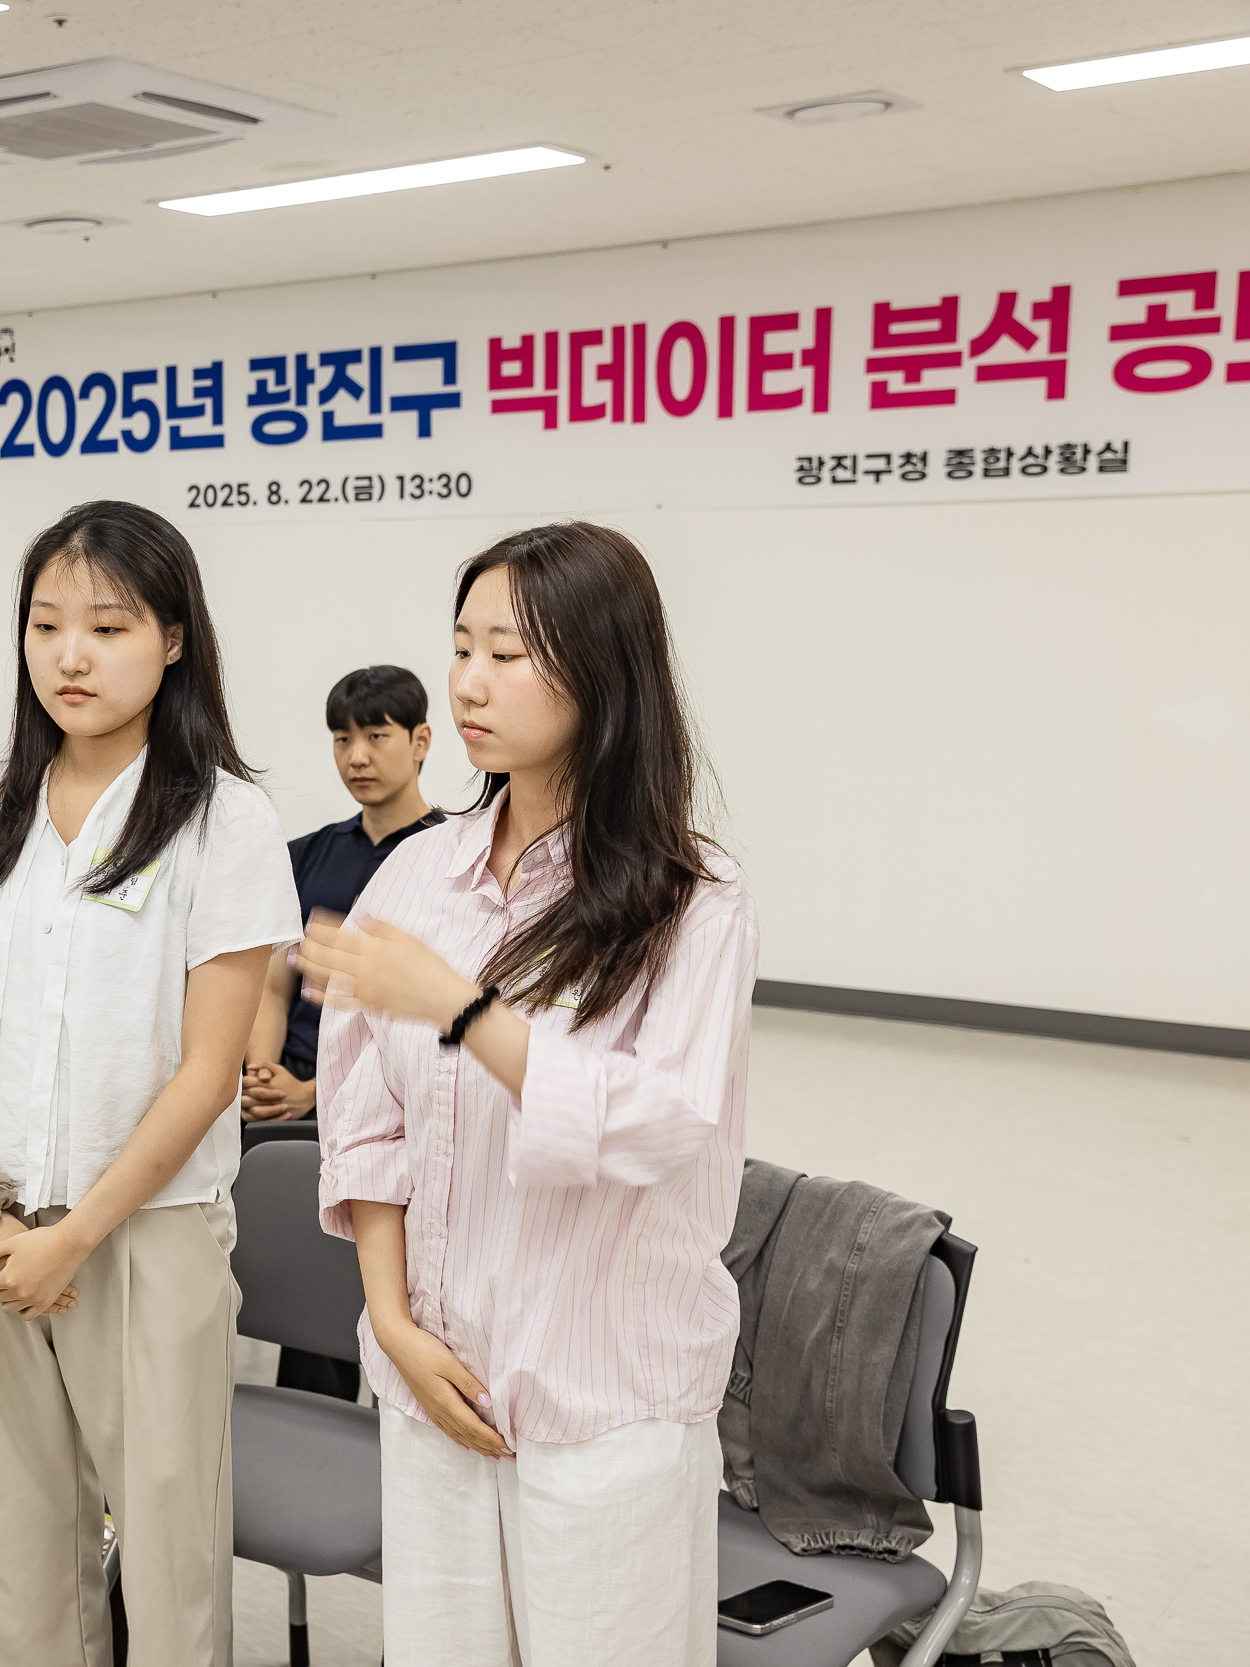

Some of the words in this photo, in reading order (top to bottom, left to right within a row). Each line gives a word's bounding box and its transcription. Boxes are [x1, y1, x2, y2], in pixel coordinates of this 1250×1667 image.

[246, 340, 462, 447] 광진구
[487, 305, 834, 431] 빅데이터
[864, 283, 1073, 411] 분석
[795, 450, 928, 486] 광진구청
[944, 440, 1130, 481] 종합상황실
[187, 482, 257, 509] 2025.
[267, 480, 289, 506] 8.
[395, 472, 472, 500] 13:30
